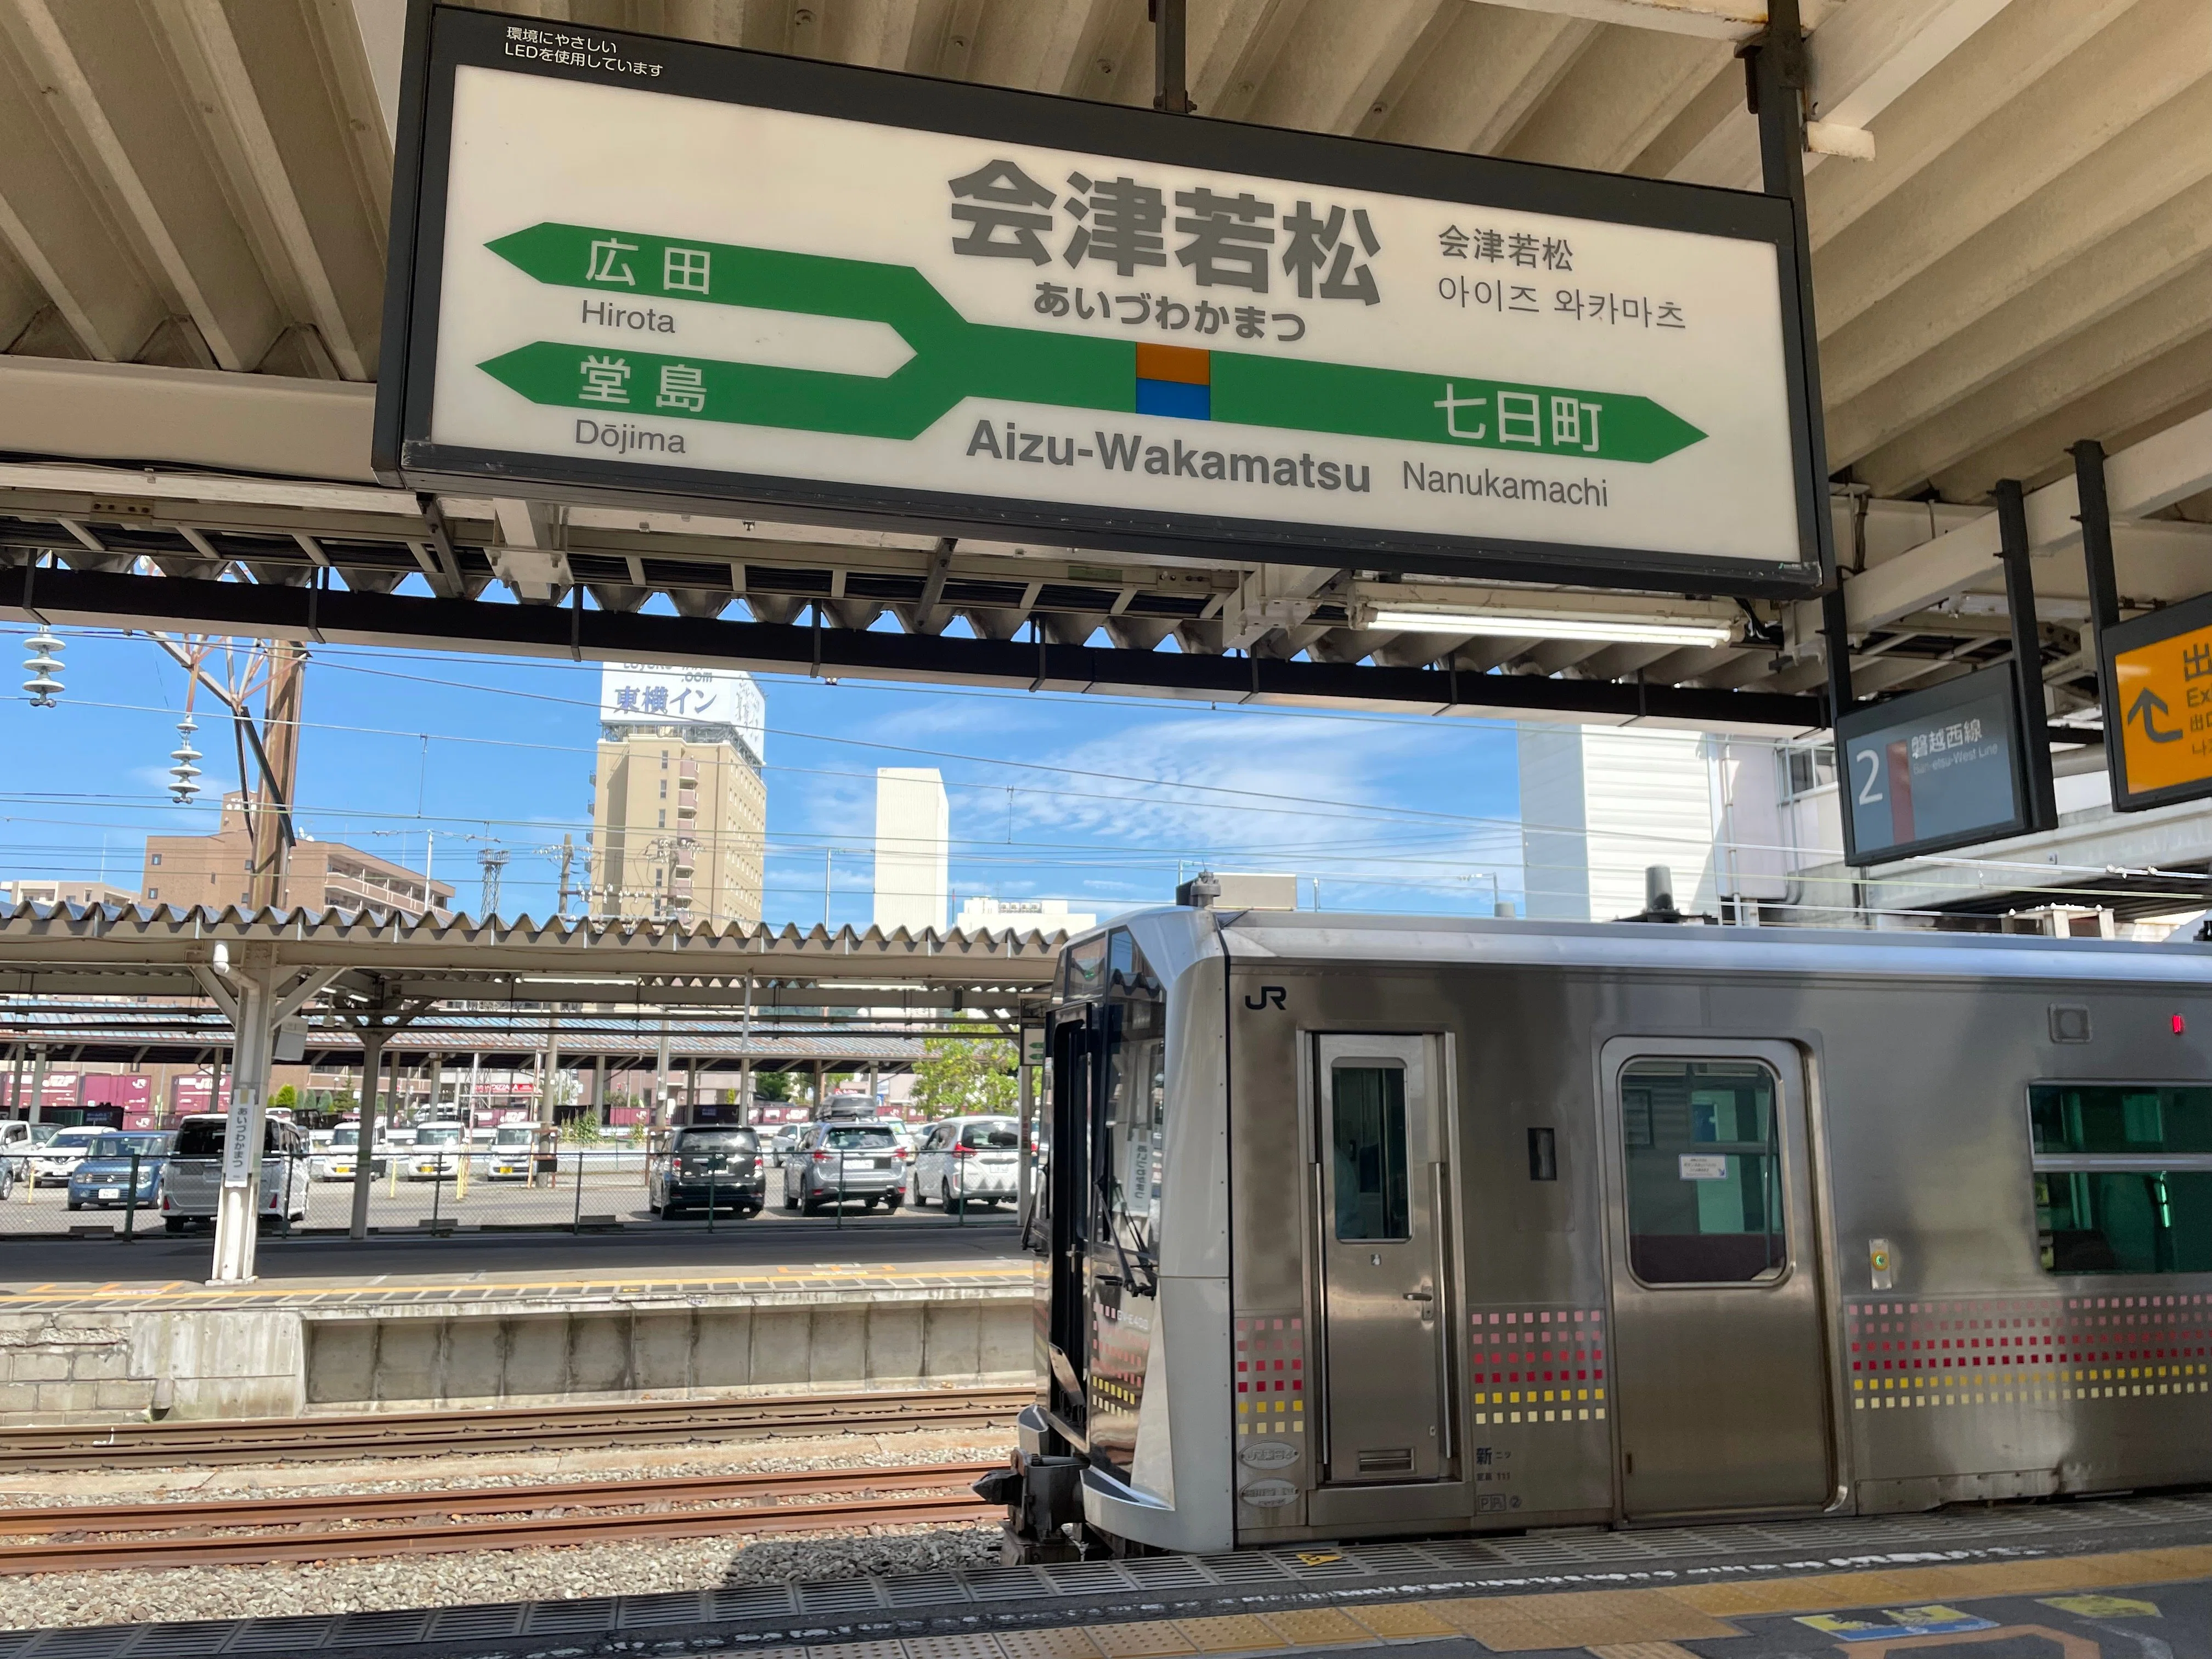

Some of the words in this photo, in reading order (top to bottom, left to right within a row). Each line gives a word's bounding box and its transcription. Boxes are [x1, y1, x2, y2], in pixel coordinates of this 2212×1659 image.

[505, 42, 663, 77] LEDを使用しています
[506, 26, 617, 54] 環境にやさしい
[948, 159, 1381, 306] 会津若松
[1438, 224, 1573, 271] 会津若松
[585, 238, 711, 295] 広田
[582, 299, 676, 334] Hirota
[1034, 282, 1306, 342] あいづわかまつ
[1438, 275, 1540, 313] 아이즈
[1554, 289, 1686, 329] 와카마츠
[578, 355, 707, 413] 堂島
[575, 419, 686, 454] Dōjima
[1434, 383, 1603, 453] 七日町
[966, 419, 1371, 493] Aizu-Wakamatsu
[1403, 460, 1608, 507] Nanukamachi
[613, 686, 717, 715] 東横イン
[1857, 749, 1883, 806] 2
[1245, 986, 1286, 1011] JR
